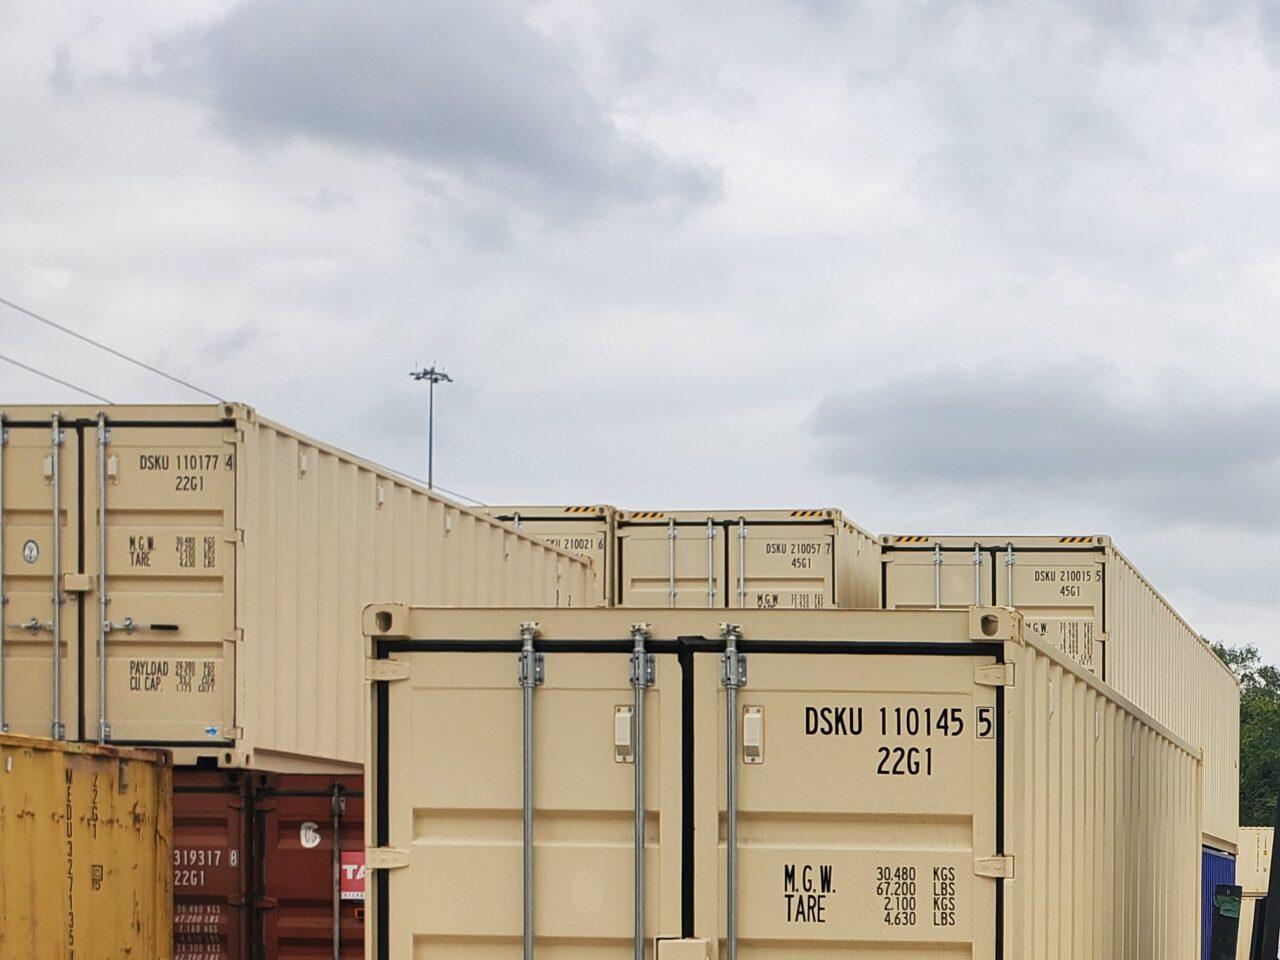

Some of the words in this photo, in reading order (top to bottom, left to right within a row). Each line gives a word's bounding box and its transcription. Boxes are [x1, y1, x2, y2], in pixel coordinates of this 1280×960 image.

[139, 455, 169, 471] DSKU
[176, 455, 219, 471] 110177
[225, 455, 233, 471] 4
[175, 476, 204, 492] 22G1
[564, 538, 593, 550] 210021
[766, 543, 787, 554] DSKU
[790, 543, 821, 554] 210057
[130, 552, 151, 567] TARE
[791, 558, 811, 568] 45G1
[1034, 570, 1056, 581] DSKU
[1060, 570, 1092, 582] 210015
[1060, 585, 1080, 596] 45G1
[129, 661, 169, 676] PAYLOAD
[805, 706, 863, 735] DSKU
[879, 707, 964, 737] 110145
[978, 708, 992, 737] 5
[877, 746, 933, 776] 22G1
[173, 849, 221, 866] 319317
[174, 870, 205, 886] 22G1
[342, 864, 366, 880] TA
[933, 866, 955, 881] KGS
[933, 881, 955, 896] LBS
[784, 894, 826, 923] TARE
[933, 896, 955, 911] KGS
[933, 911, 955, 926] LBS
